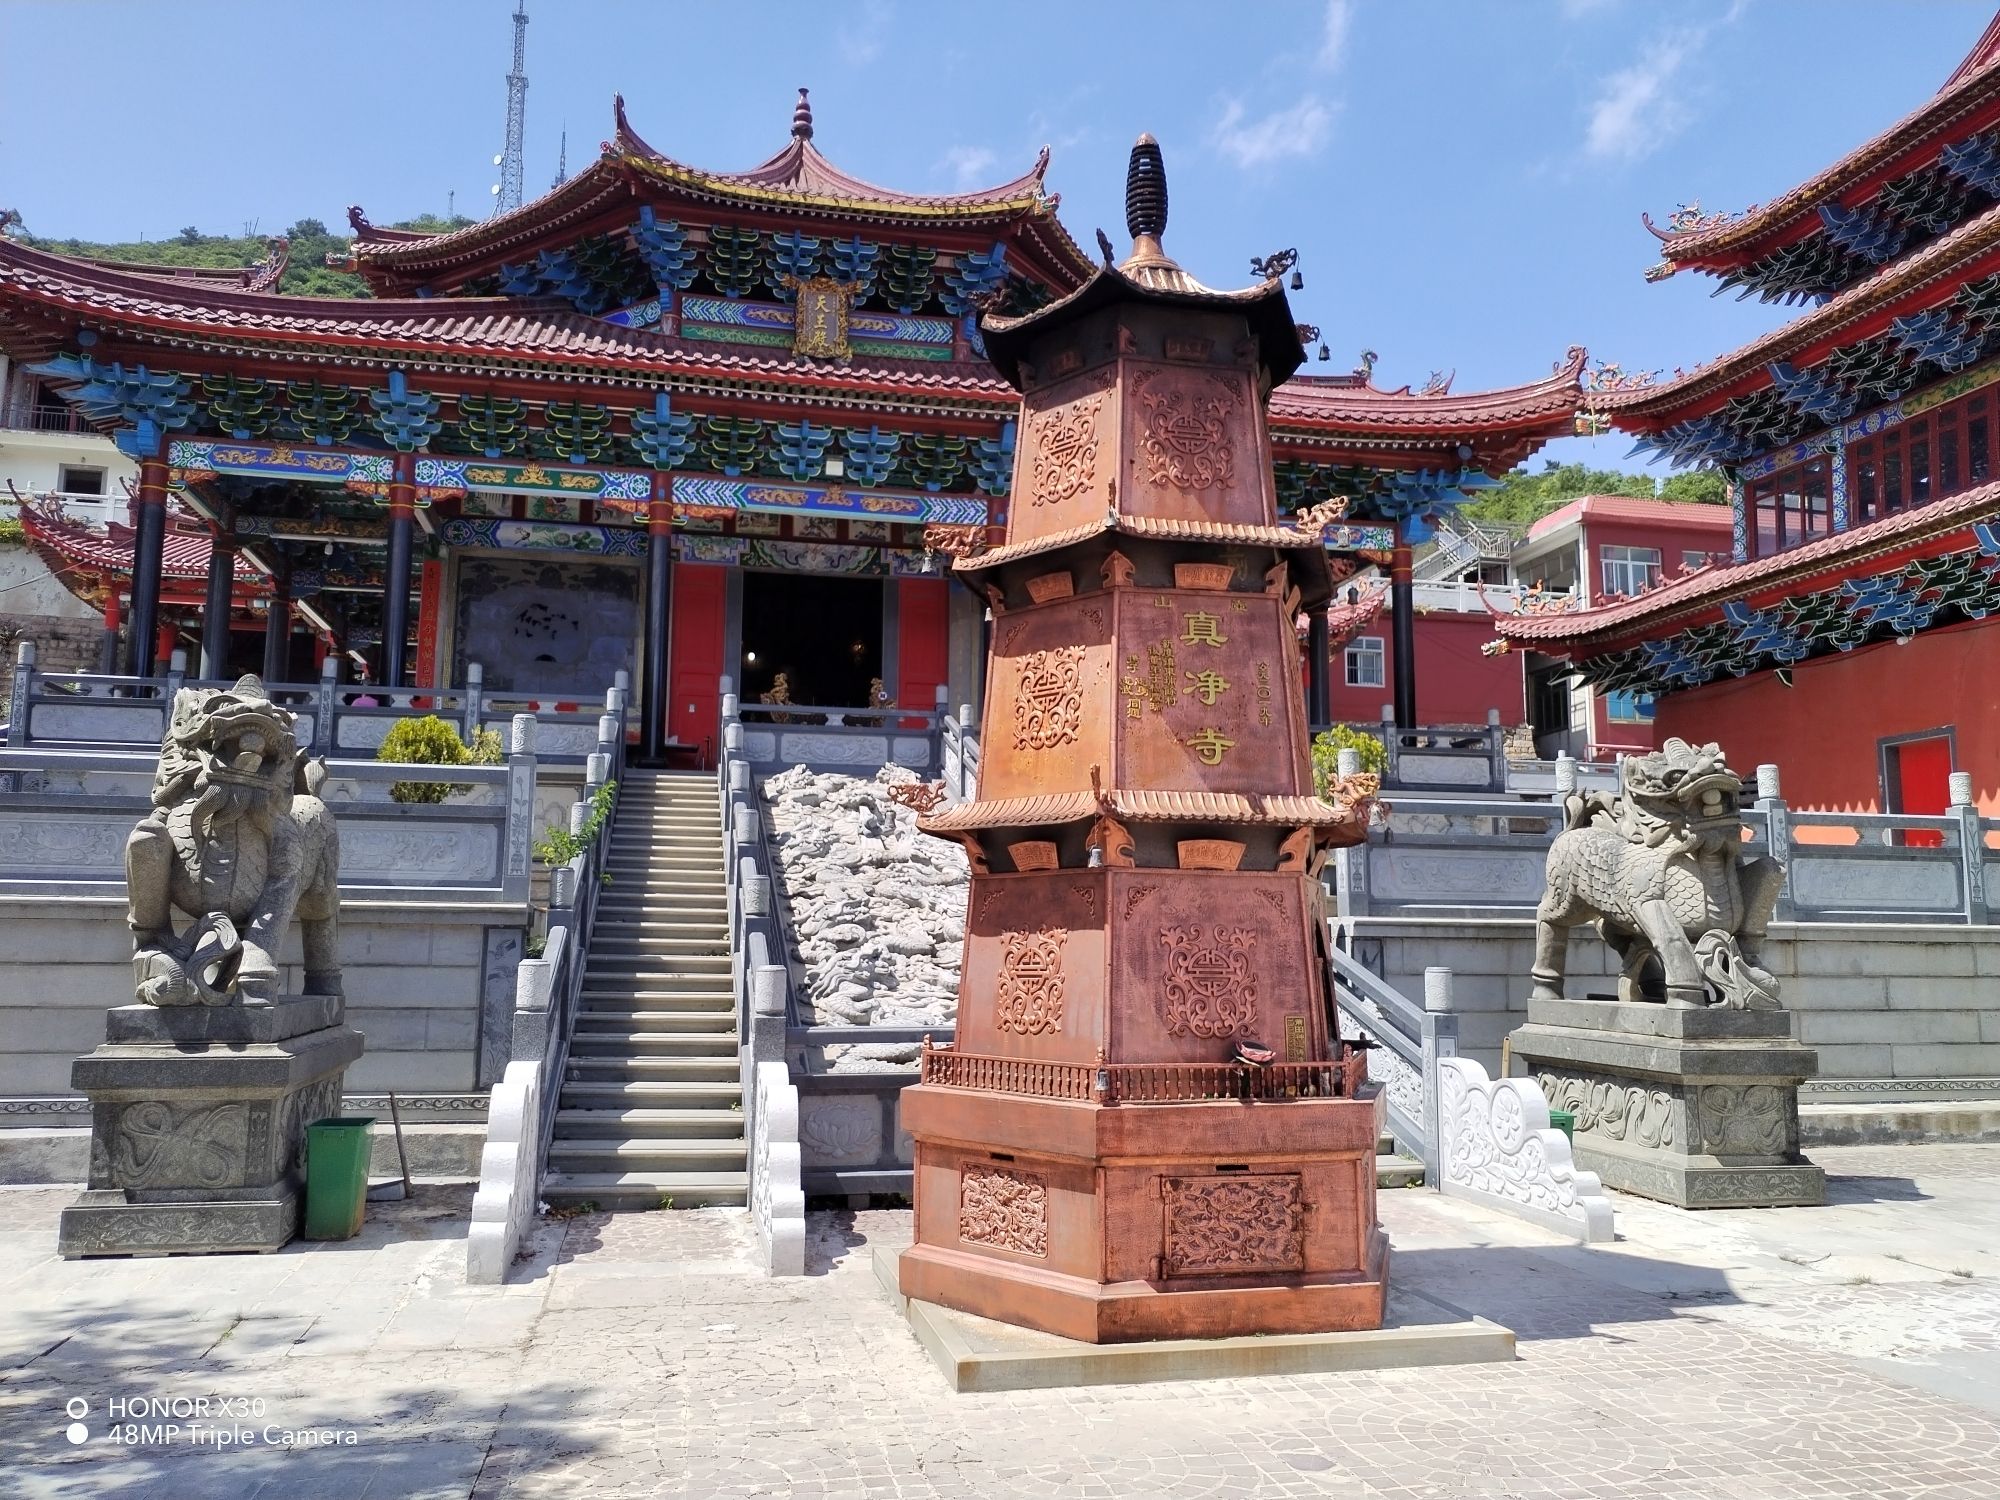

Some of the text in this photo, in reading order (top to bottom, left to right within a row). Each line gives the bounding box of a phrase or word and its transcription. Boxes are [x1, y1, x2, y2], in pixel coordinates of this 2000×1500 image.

[811, 294, 831, 348] 天王殿
[1179, 611, 1236, 766] 真净寺
